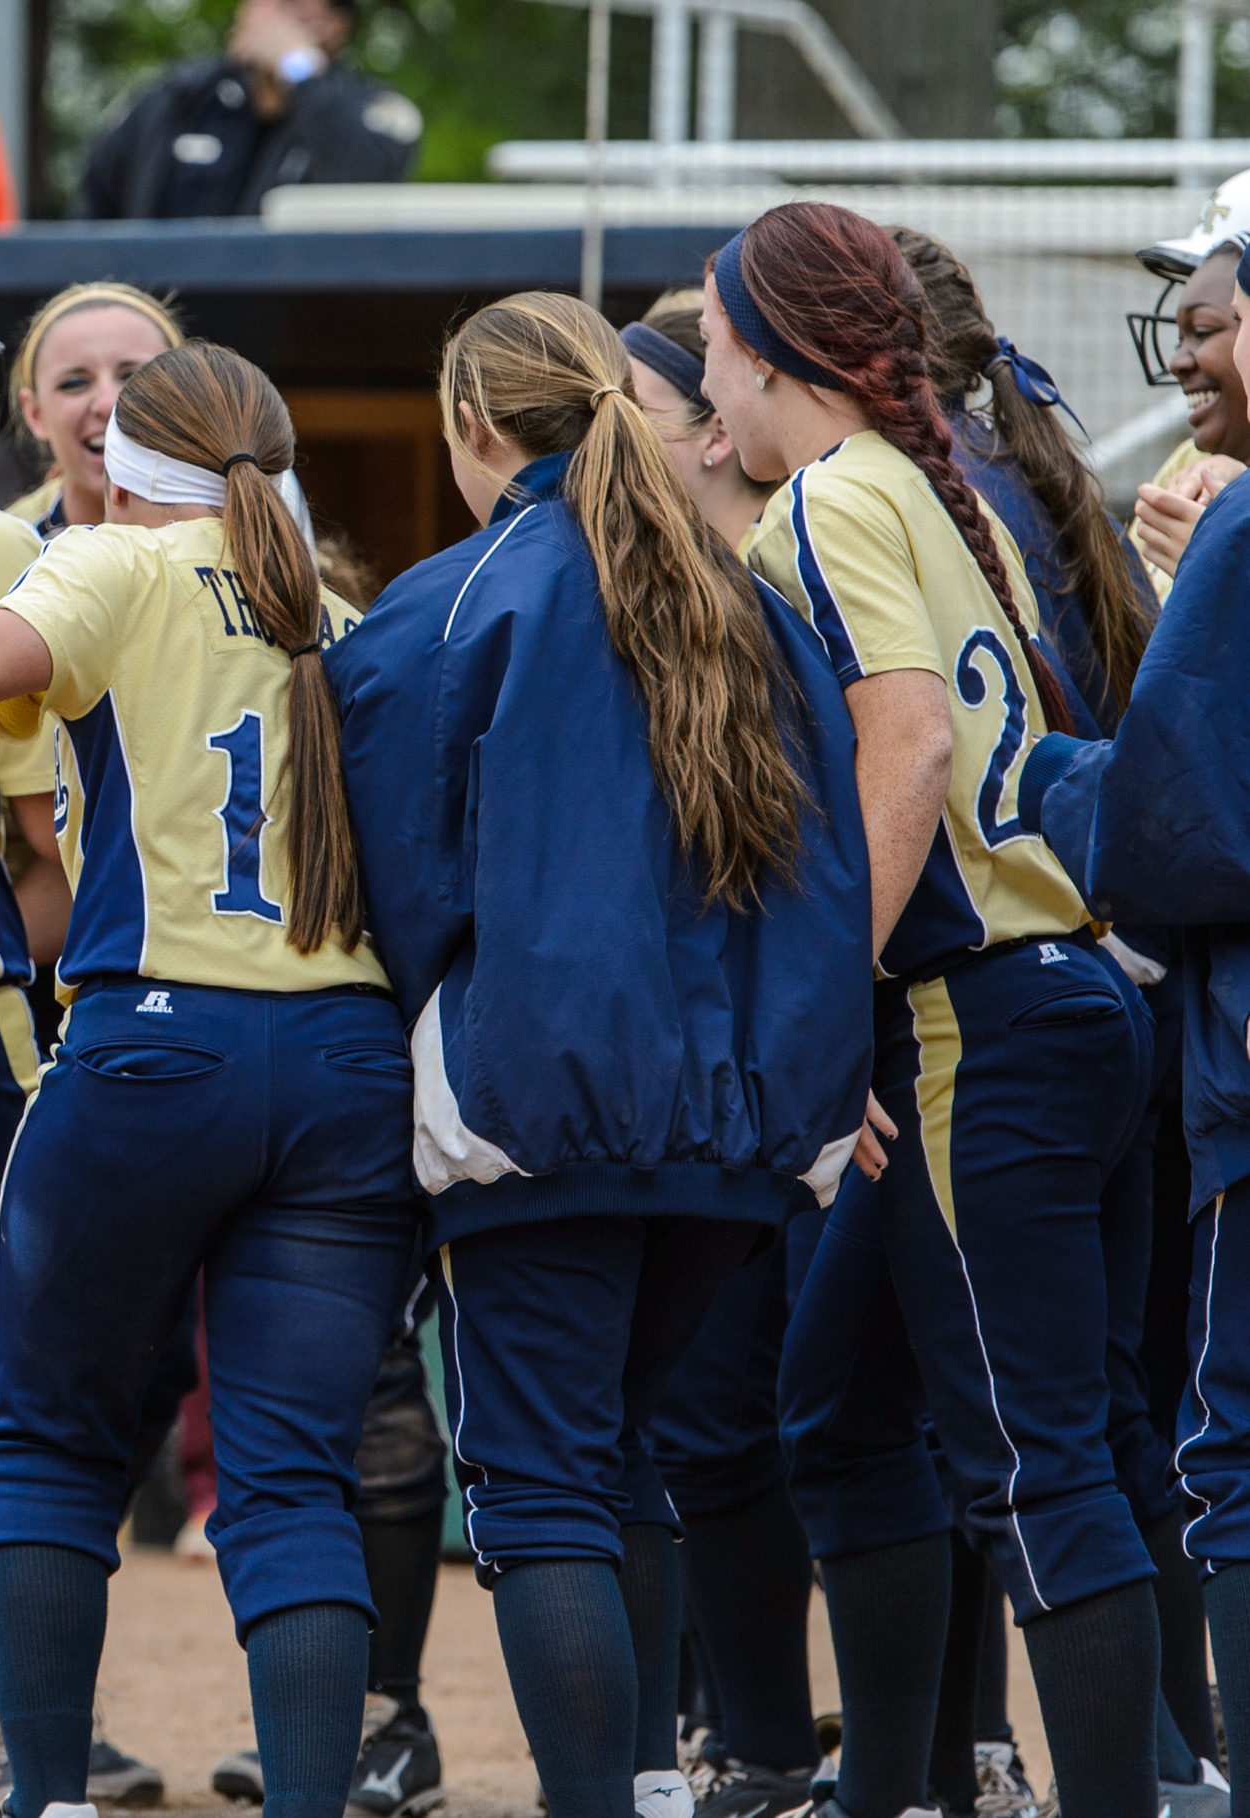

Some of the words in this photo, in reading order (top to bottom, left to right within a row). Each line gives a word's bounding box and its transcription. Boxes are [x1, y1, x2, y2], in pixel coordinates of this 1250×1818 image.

[206, 708, 287, 927] 1
[952, 625, 1042, 854] 2
[135, 1003, 174, 1014] RUSSELL
